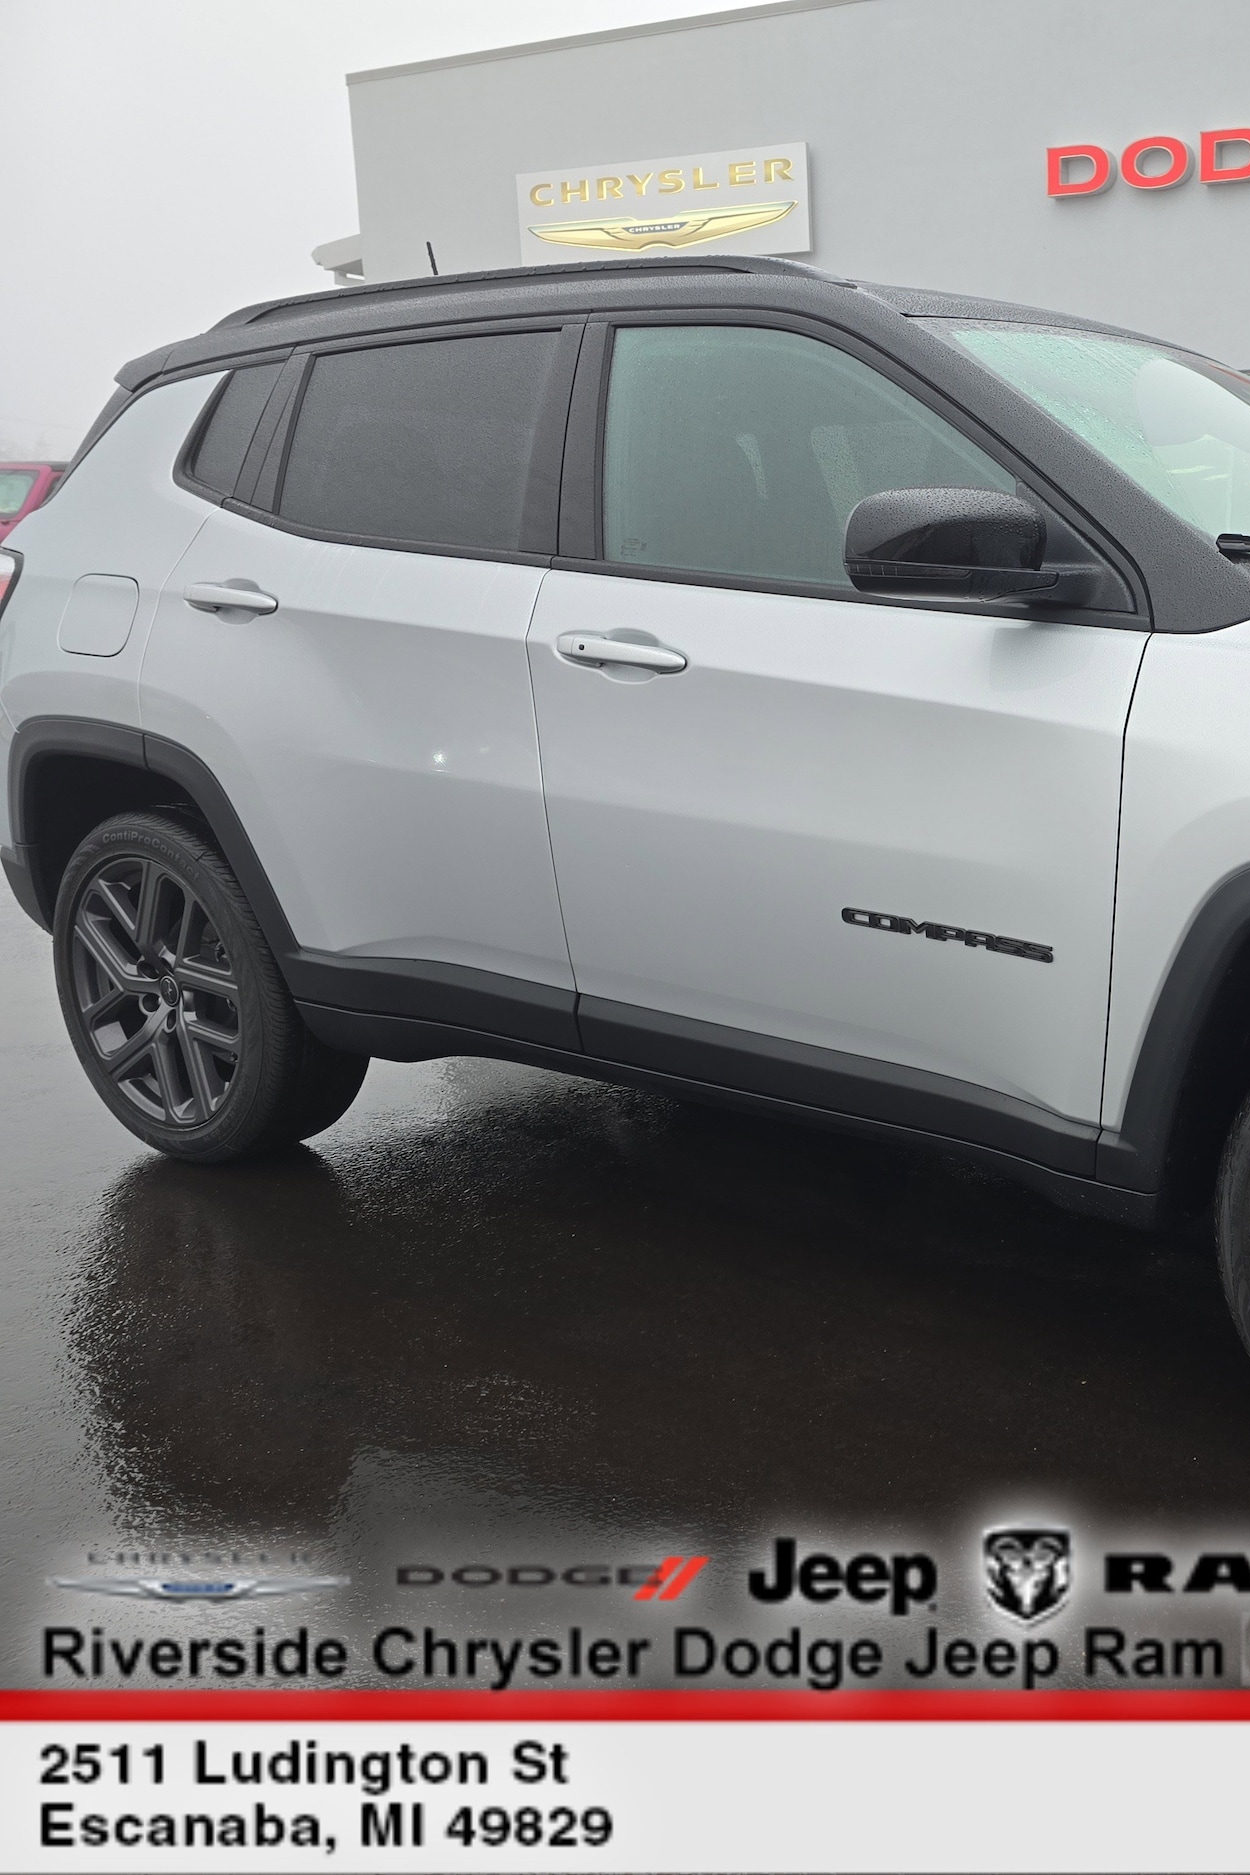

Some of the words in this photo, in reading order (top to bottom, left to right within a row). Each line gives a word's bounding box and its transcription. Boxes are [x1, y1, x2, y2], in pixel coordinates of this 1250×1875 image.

[529, 157, 795, 207] CHRYSLER
[628, 223, 681, 233] CHRYSLER
[102, 830, 202, 883] ContiProContact
[841, 906, 1054, 964] COMPASS
